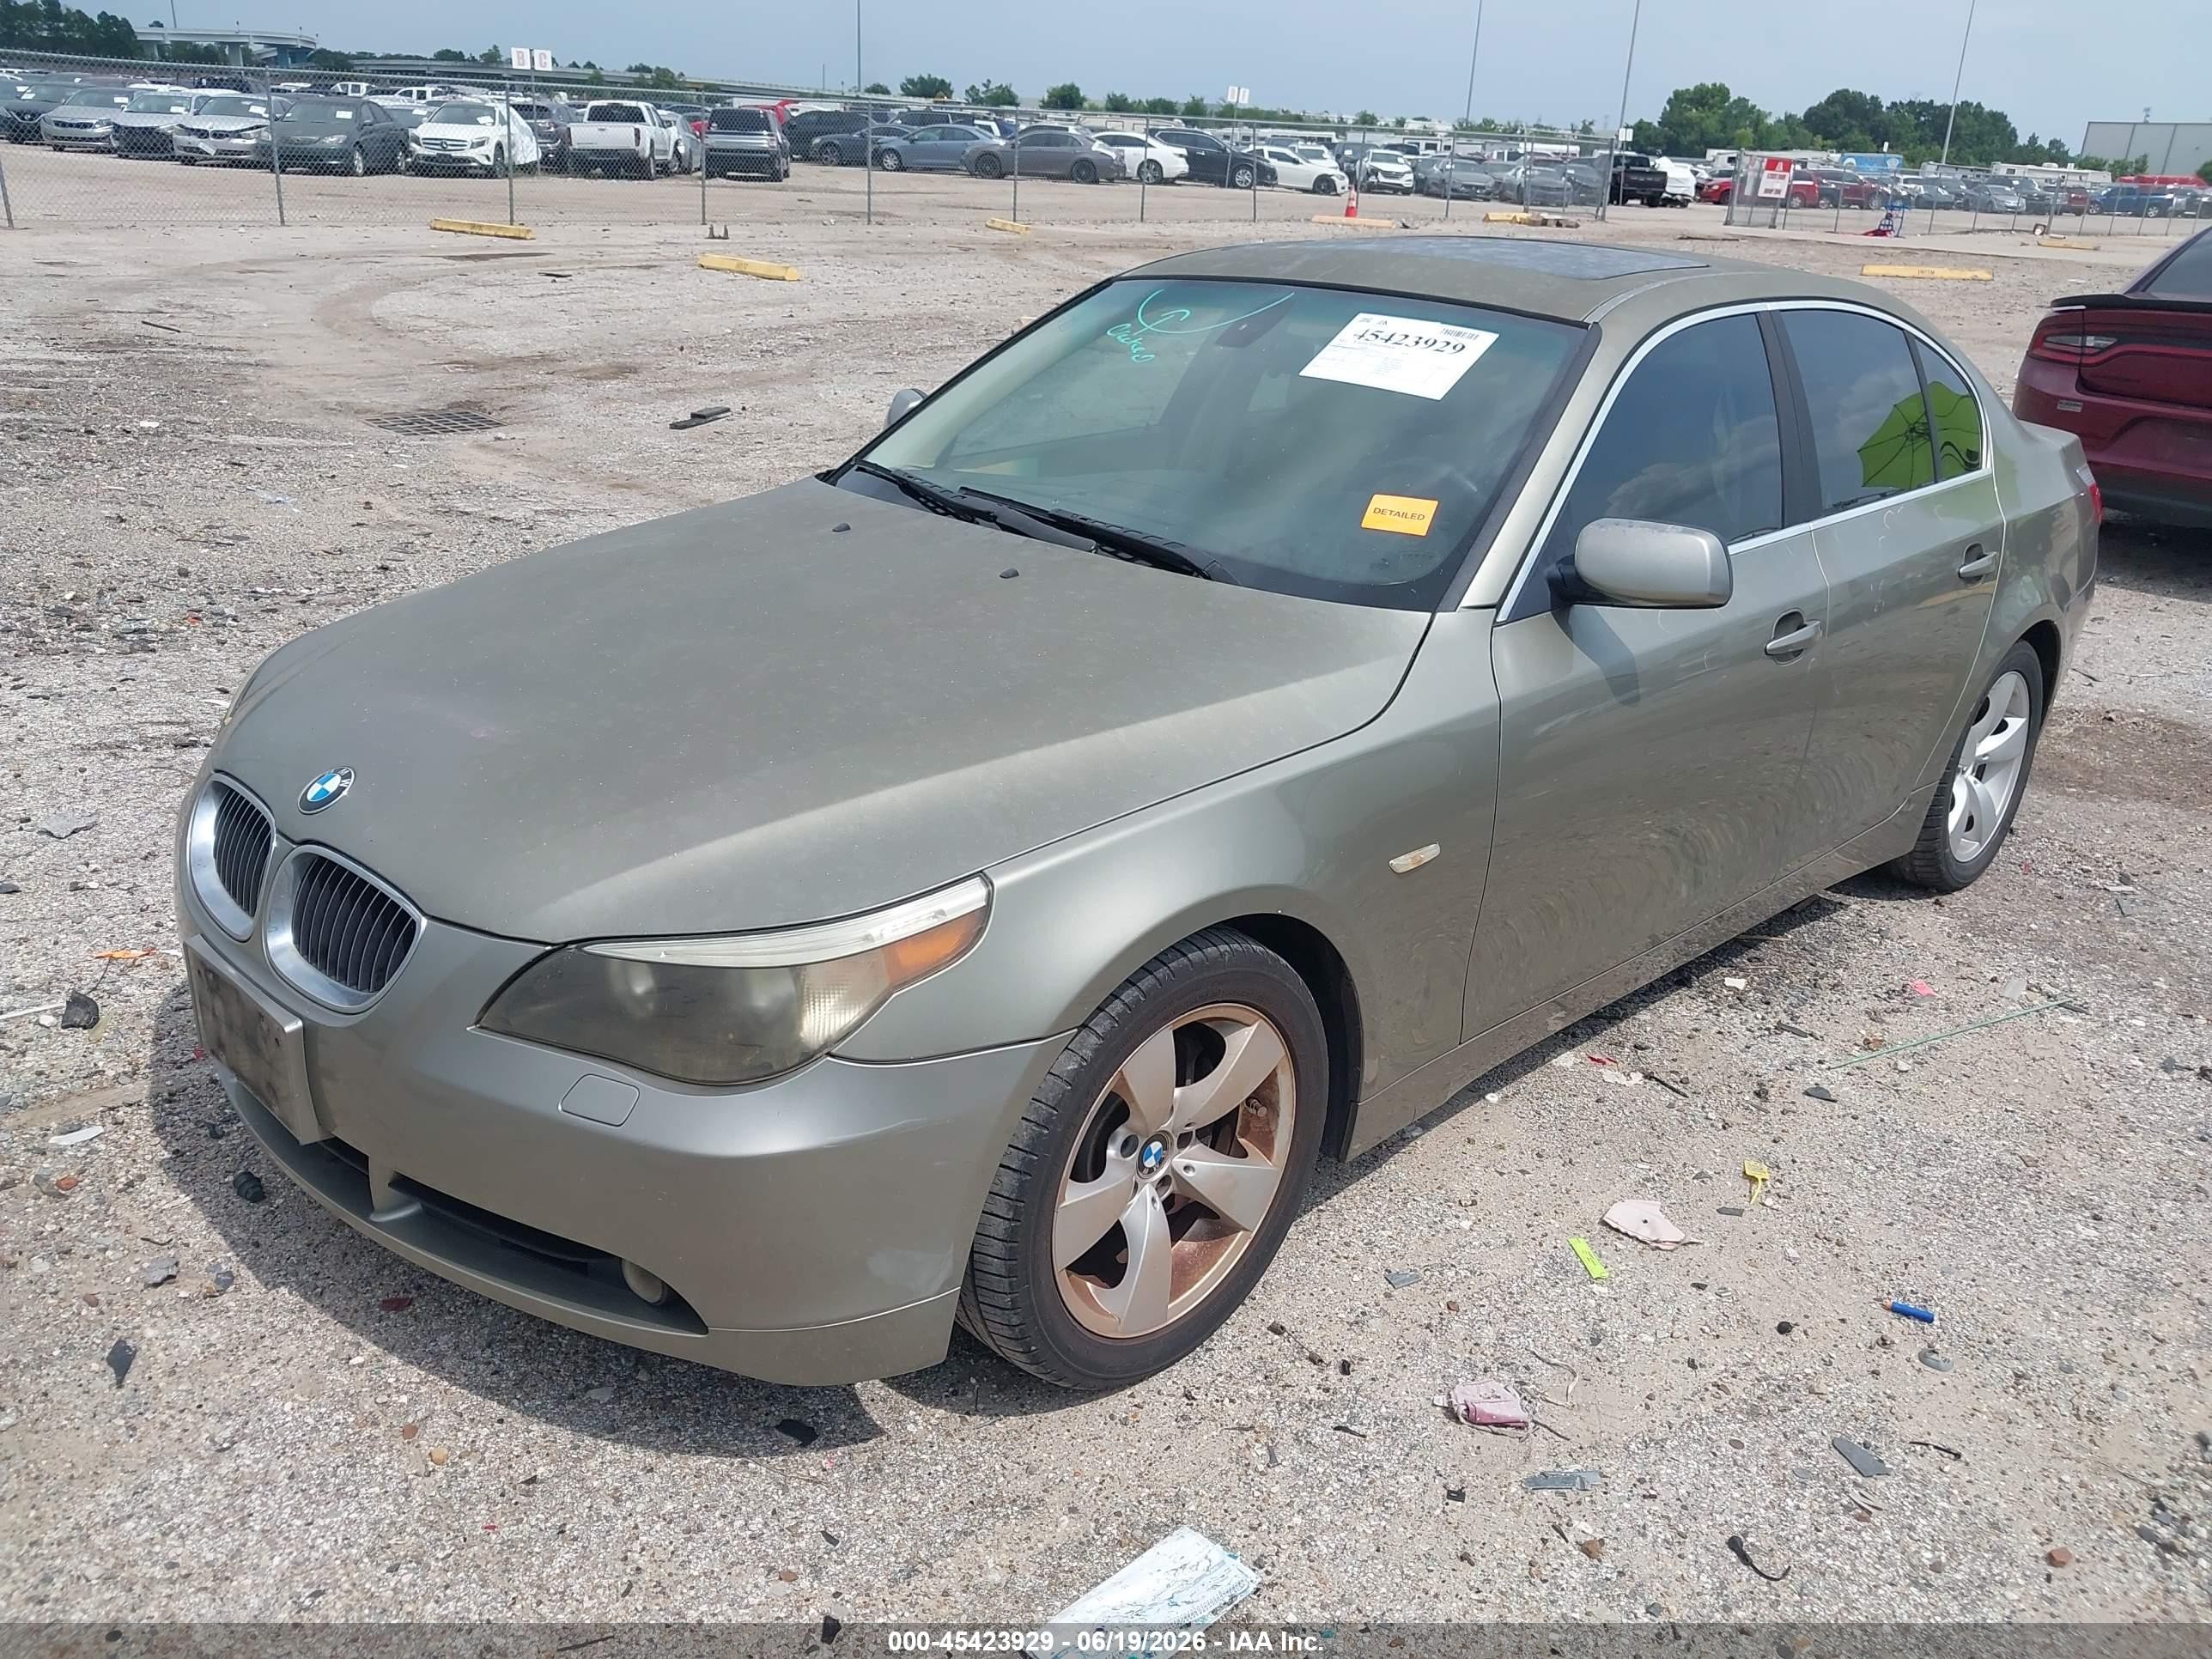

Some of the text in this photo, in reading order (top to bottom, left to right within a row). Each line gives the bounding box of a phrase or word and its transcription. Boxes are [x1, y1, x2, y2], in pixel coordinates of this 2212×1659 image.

[516, 51, 525, 66] B
[1353, 329, 1466, 354] 45423929
[1373, 507, 1425, 521] DETAILED
